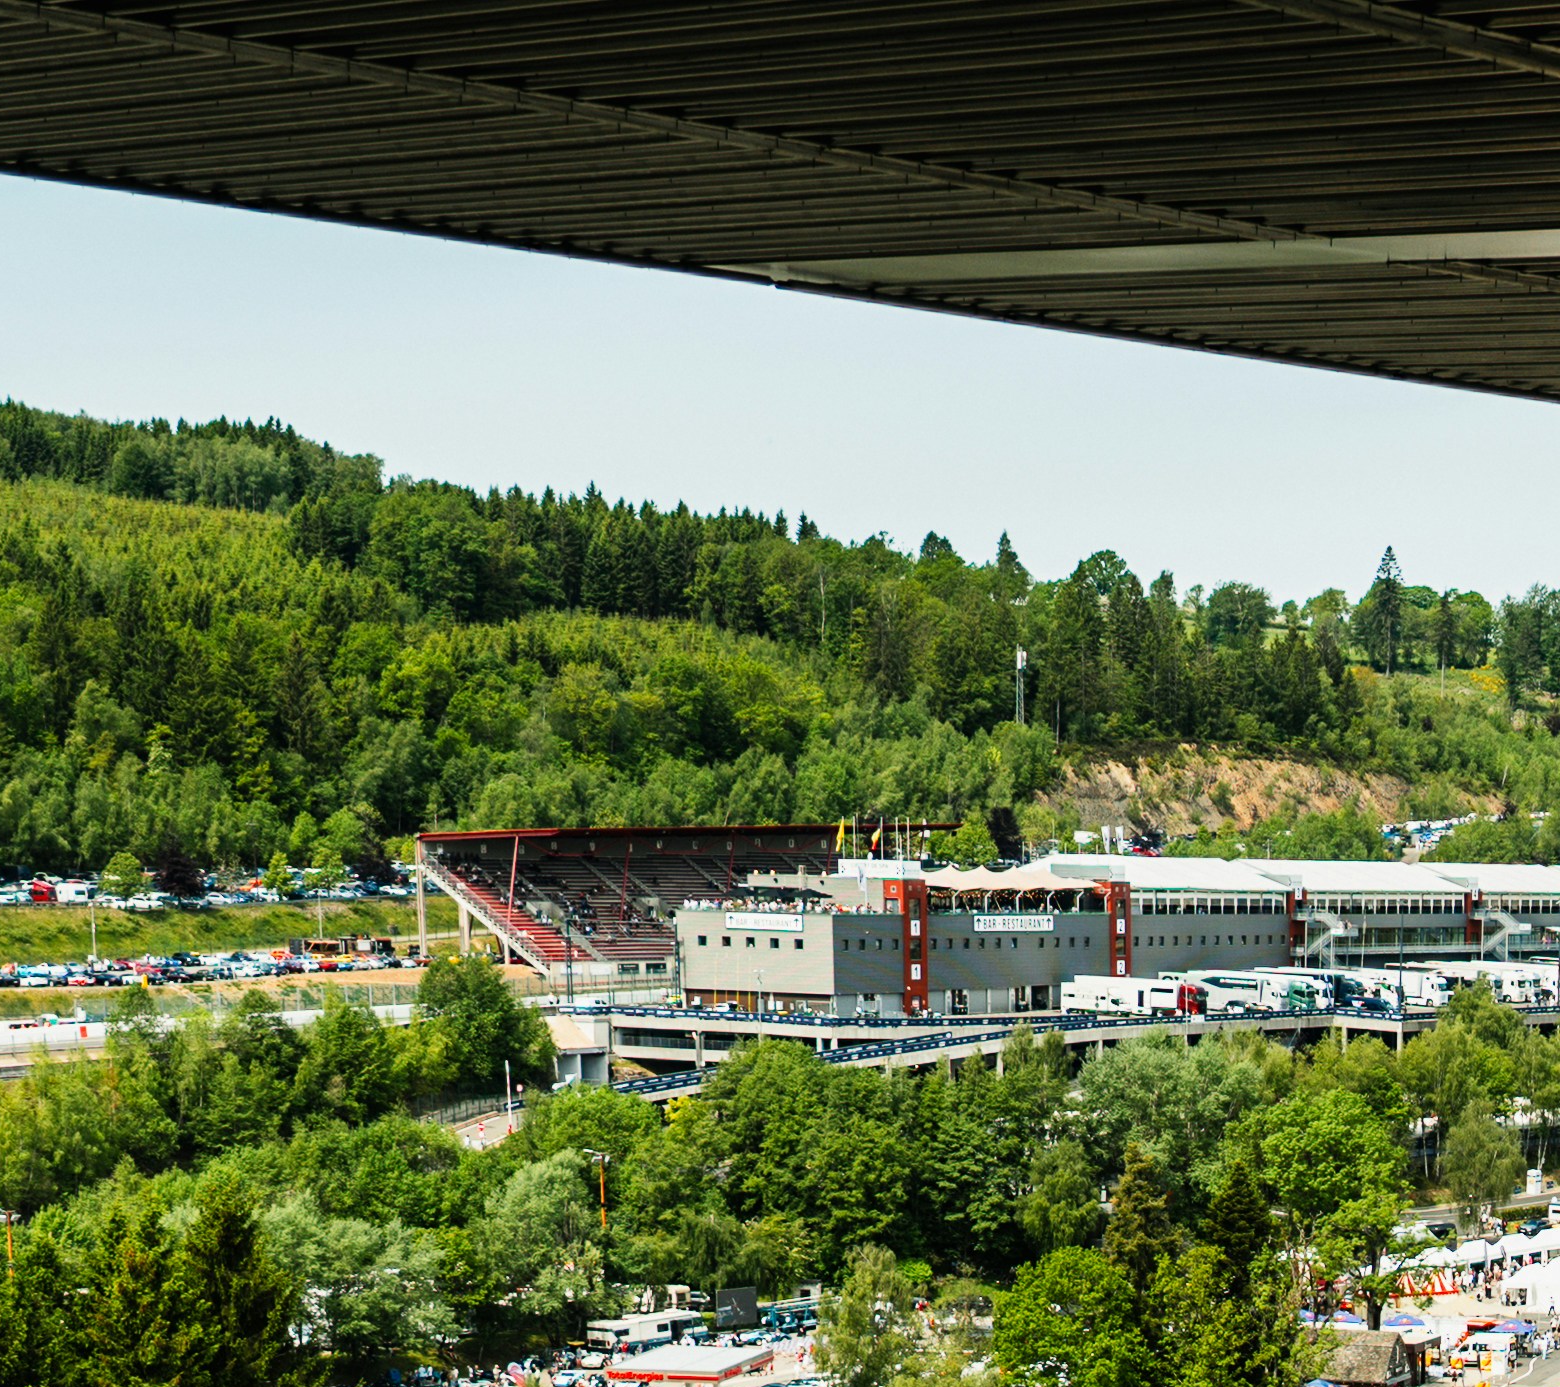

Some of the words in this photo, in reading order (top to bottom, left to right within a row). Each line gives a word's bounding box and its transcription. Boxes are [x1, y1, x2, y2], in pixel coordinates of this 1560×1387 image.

[983, 918, 997, 929] BAR
[1003, 918, 1046, 930] RESTAURANT
[606, 1371, 664, 1383] TotalEnergies
